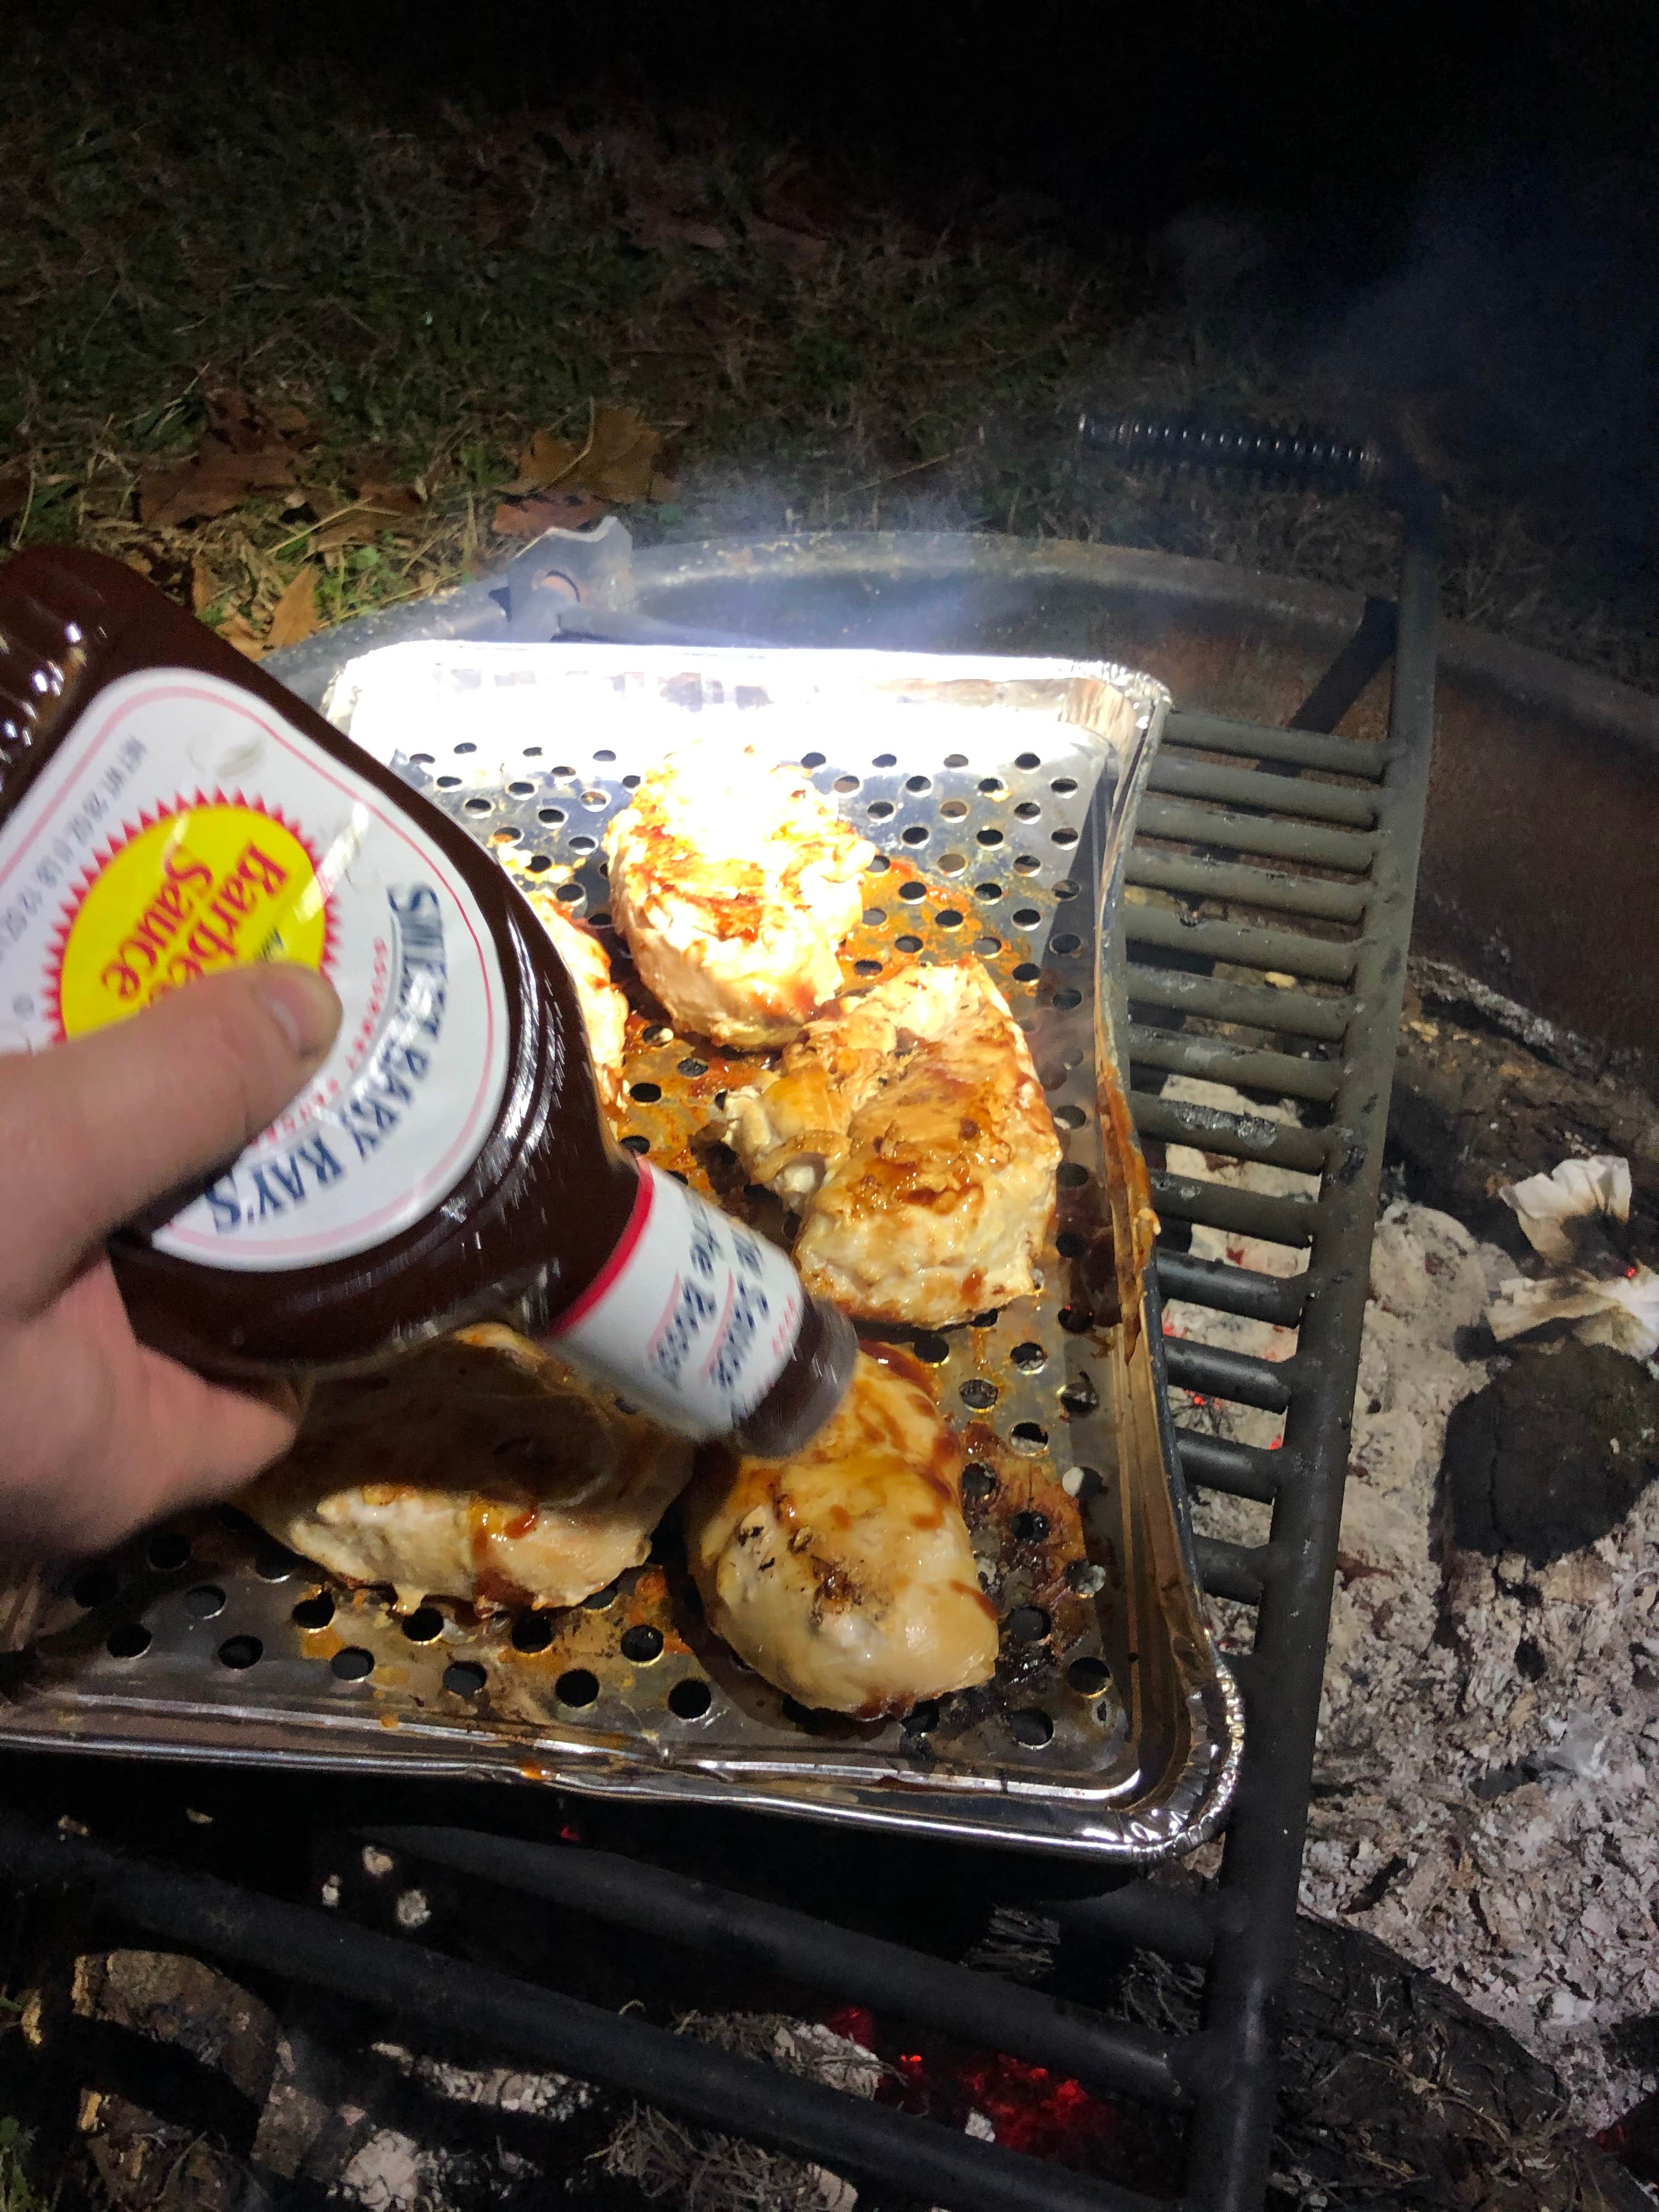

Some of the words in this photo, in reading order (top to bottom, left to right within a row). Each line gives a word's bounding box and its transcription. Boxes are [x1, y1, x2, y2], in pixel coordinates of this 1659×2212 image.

[100, 842, 215, 1002] Sauce
[147, 838, 292, 1011] Barbe
[386, 881, 448, 1039] SWEET
[337, 1039, 430, 1160] BABY
[202, 1127, 346, 1233] RAY'S
